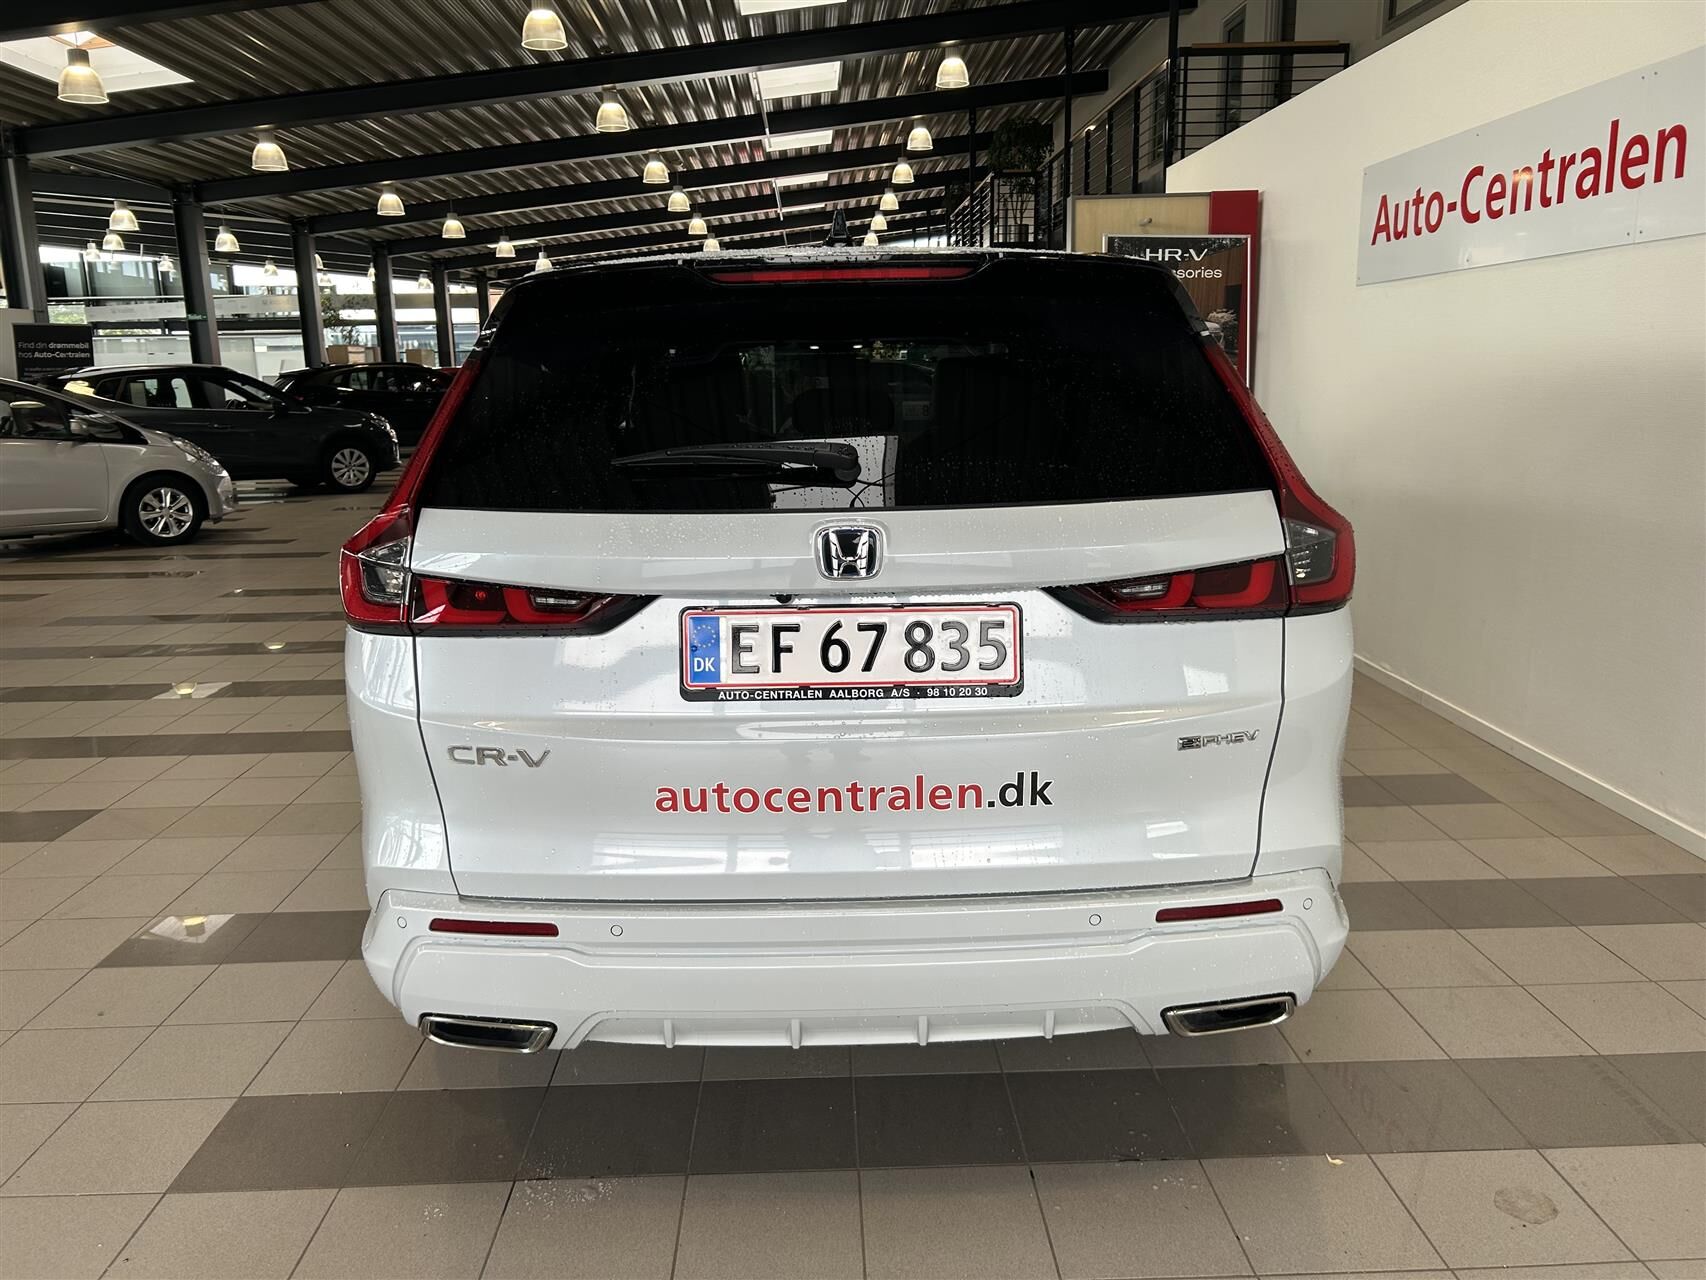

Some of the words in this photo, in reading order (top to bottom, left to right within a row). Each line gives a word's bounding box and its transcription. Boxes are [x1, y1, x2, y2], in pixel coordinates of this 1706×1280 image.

[1370, 117, 1688, 247] Auto-Centralen
[1145, 248, 1208, 262] HR-V
[18, 341, 34, 349] Find
[35, 341, 47, 349] din
[18, 351, 33, 359] hos
[731, 623, 801, 675] EF
[819, 620, 888, 674] 67
[903, 620, 1008, 673] 835
[693, 656, 716, 672] DK
[718, 689, 823, 700] AUTO-CENTRALEN
[829, 688, 884, 699] AALBORG
[891, 688, 911, 697] A/S
[927, 688, 940, 697] 98
[943, 688, 956, 697] 10
[959, 687, 972, 697] 20
[974, 687, 988, 696] 30
[447, 745, 551, 768] CR-V
[654, 770, 1054, 814] autocentralen.dk
